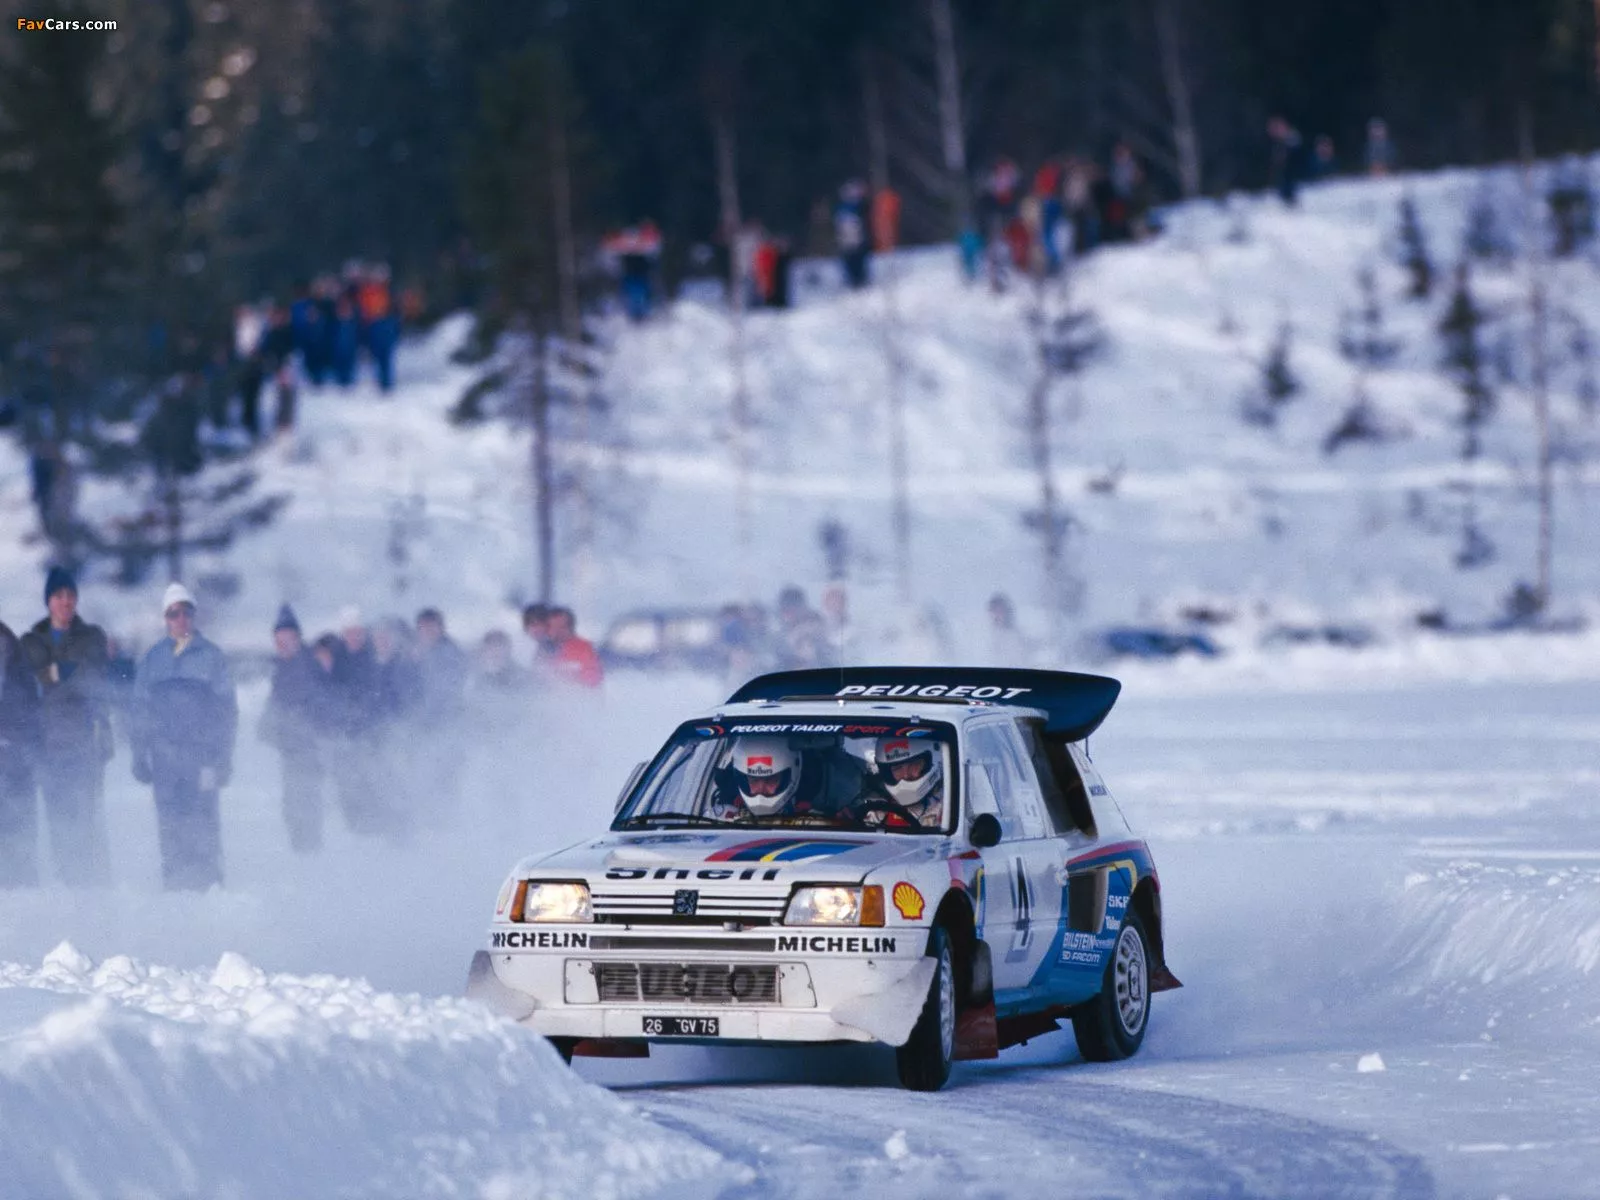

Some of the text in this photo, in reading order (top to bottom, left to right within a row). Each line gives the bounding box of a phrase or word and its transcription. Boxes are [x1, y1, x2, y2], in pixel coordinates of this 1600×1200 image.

[835, 685, 1032, 699] PEUGEOT
[730, 724, 890, 733] PEUGEOT TALBOT SPORT
[778, 936, 896, 953] MICHELIN
[646, 1018, 717, 1034] 26 GV 75
